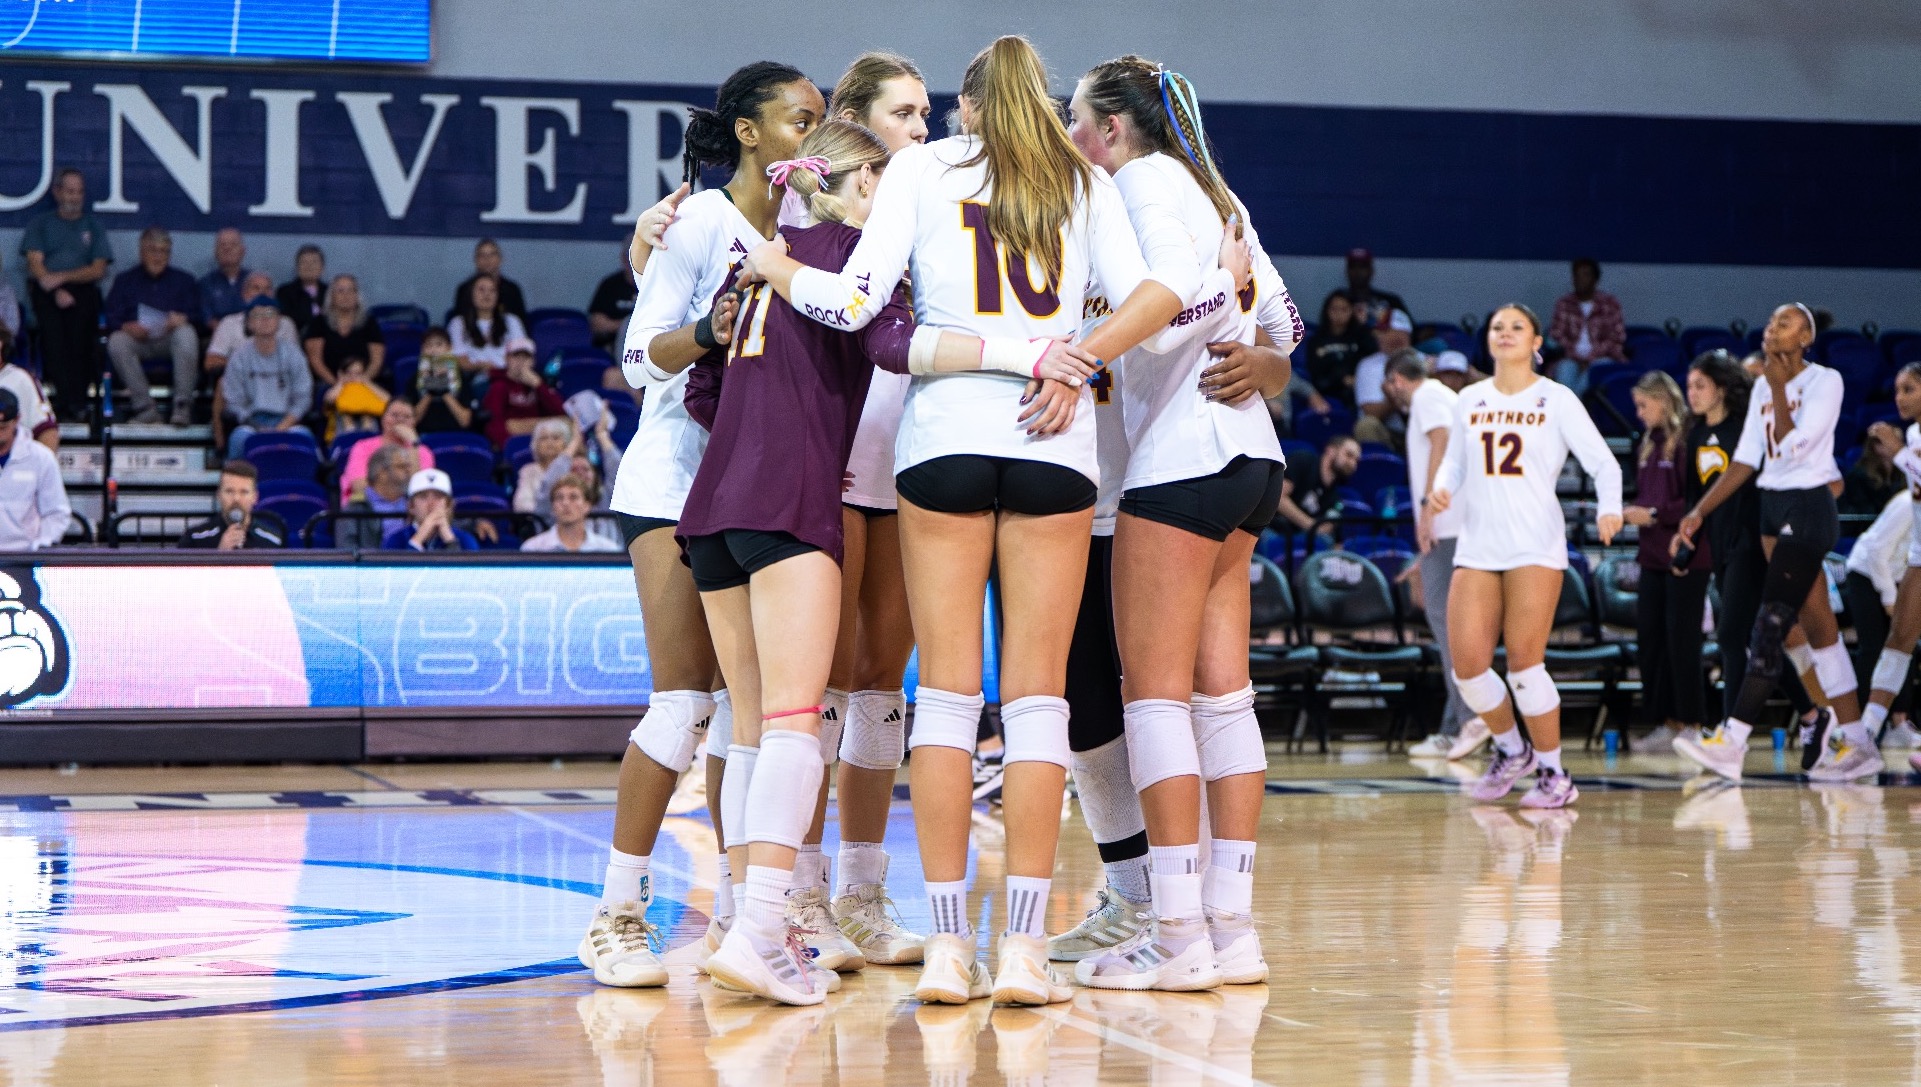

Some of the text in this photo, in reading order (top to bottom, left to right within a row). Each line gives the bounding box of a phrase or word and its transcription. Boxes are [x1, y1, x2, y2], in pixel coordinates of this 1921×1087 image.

[959, 199, 1064, 319] 10
[804, 303, 851, 326] ROCK
[1469, 410, 1547, 427] WINTHROP
[1480, 430, 1524, 477] 12
[393, 592, 653, 697] BIG
